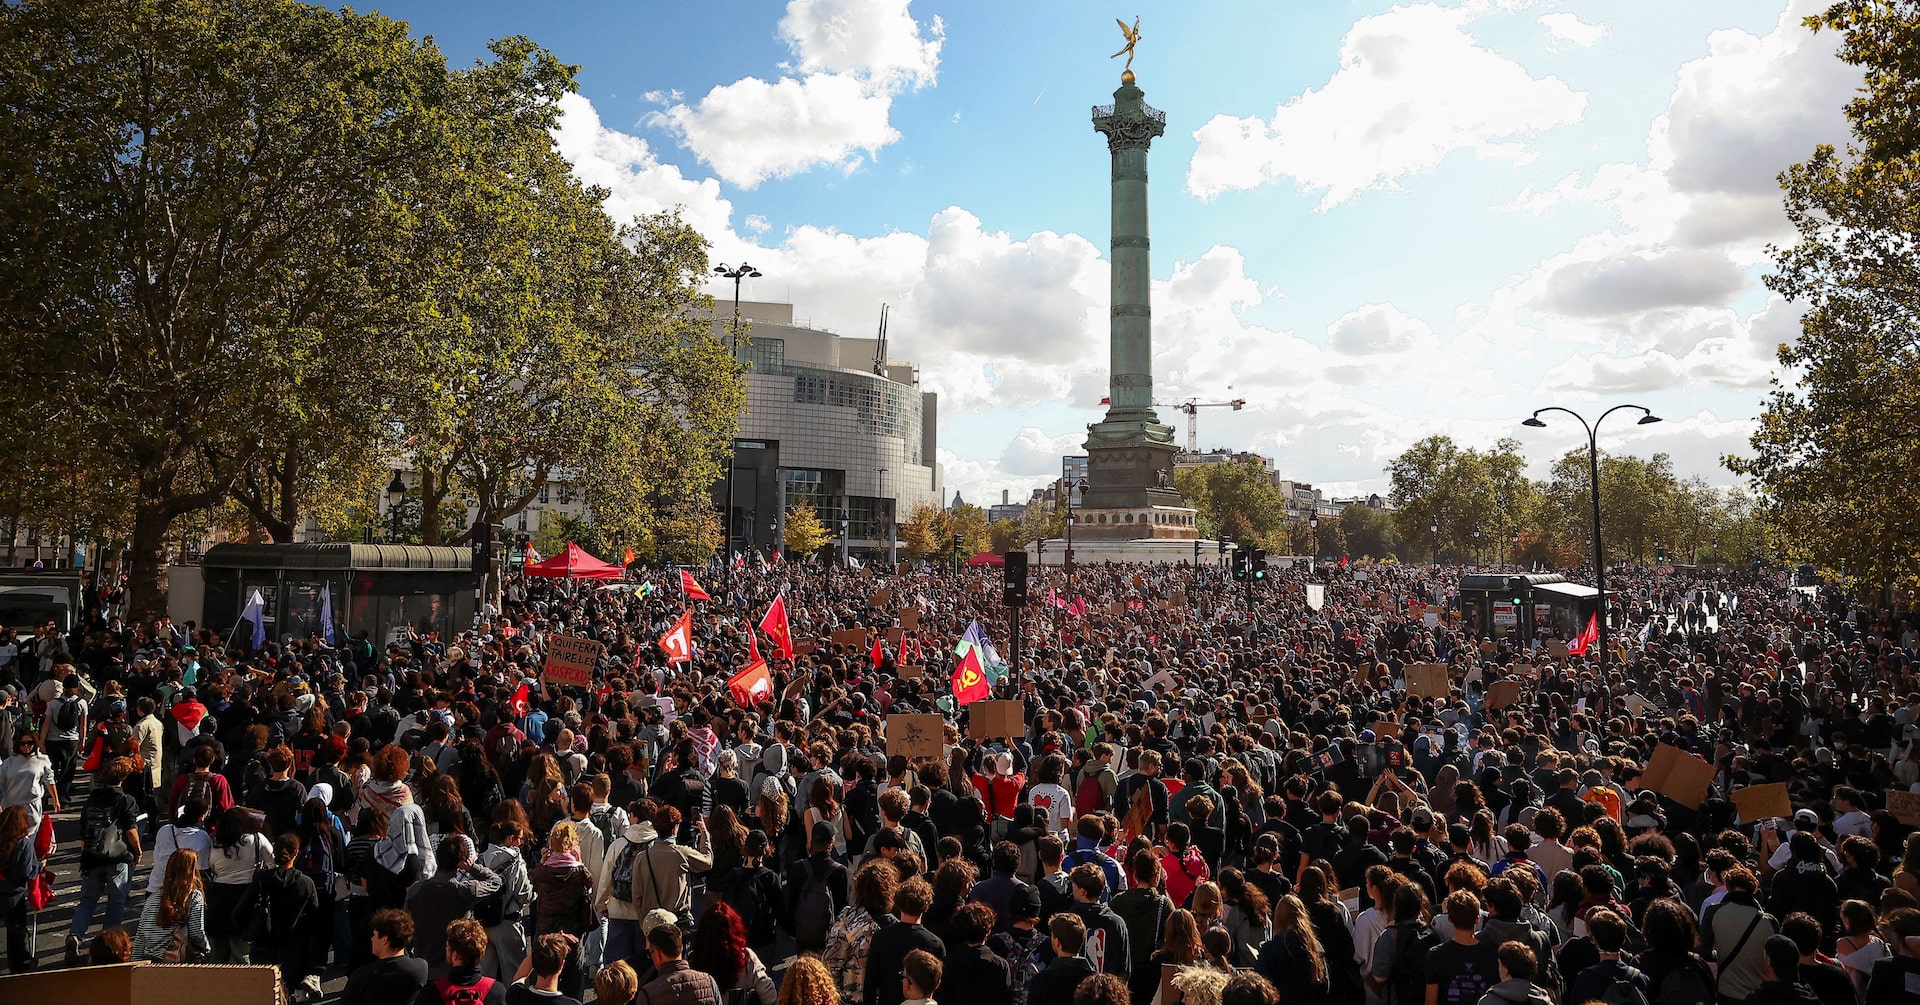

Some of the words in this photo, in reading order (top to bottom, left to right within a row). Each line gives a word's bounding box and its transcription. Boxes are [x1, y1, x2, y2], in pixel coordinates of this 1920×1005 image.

[554, 639, 572, 649] QUI
[573, 641, 597, 655] FERA
[550, 648, 577, 663] TAIRE
[578, 655, 595, 667] LES
